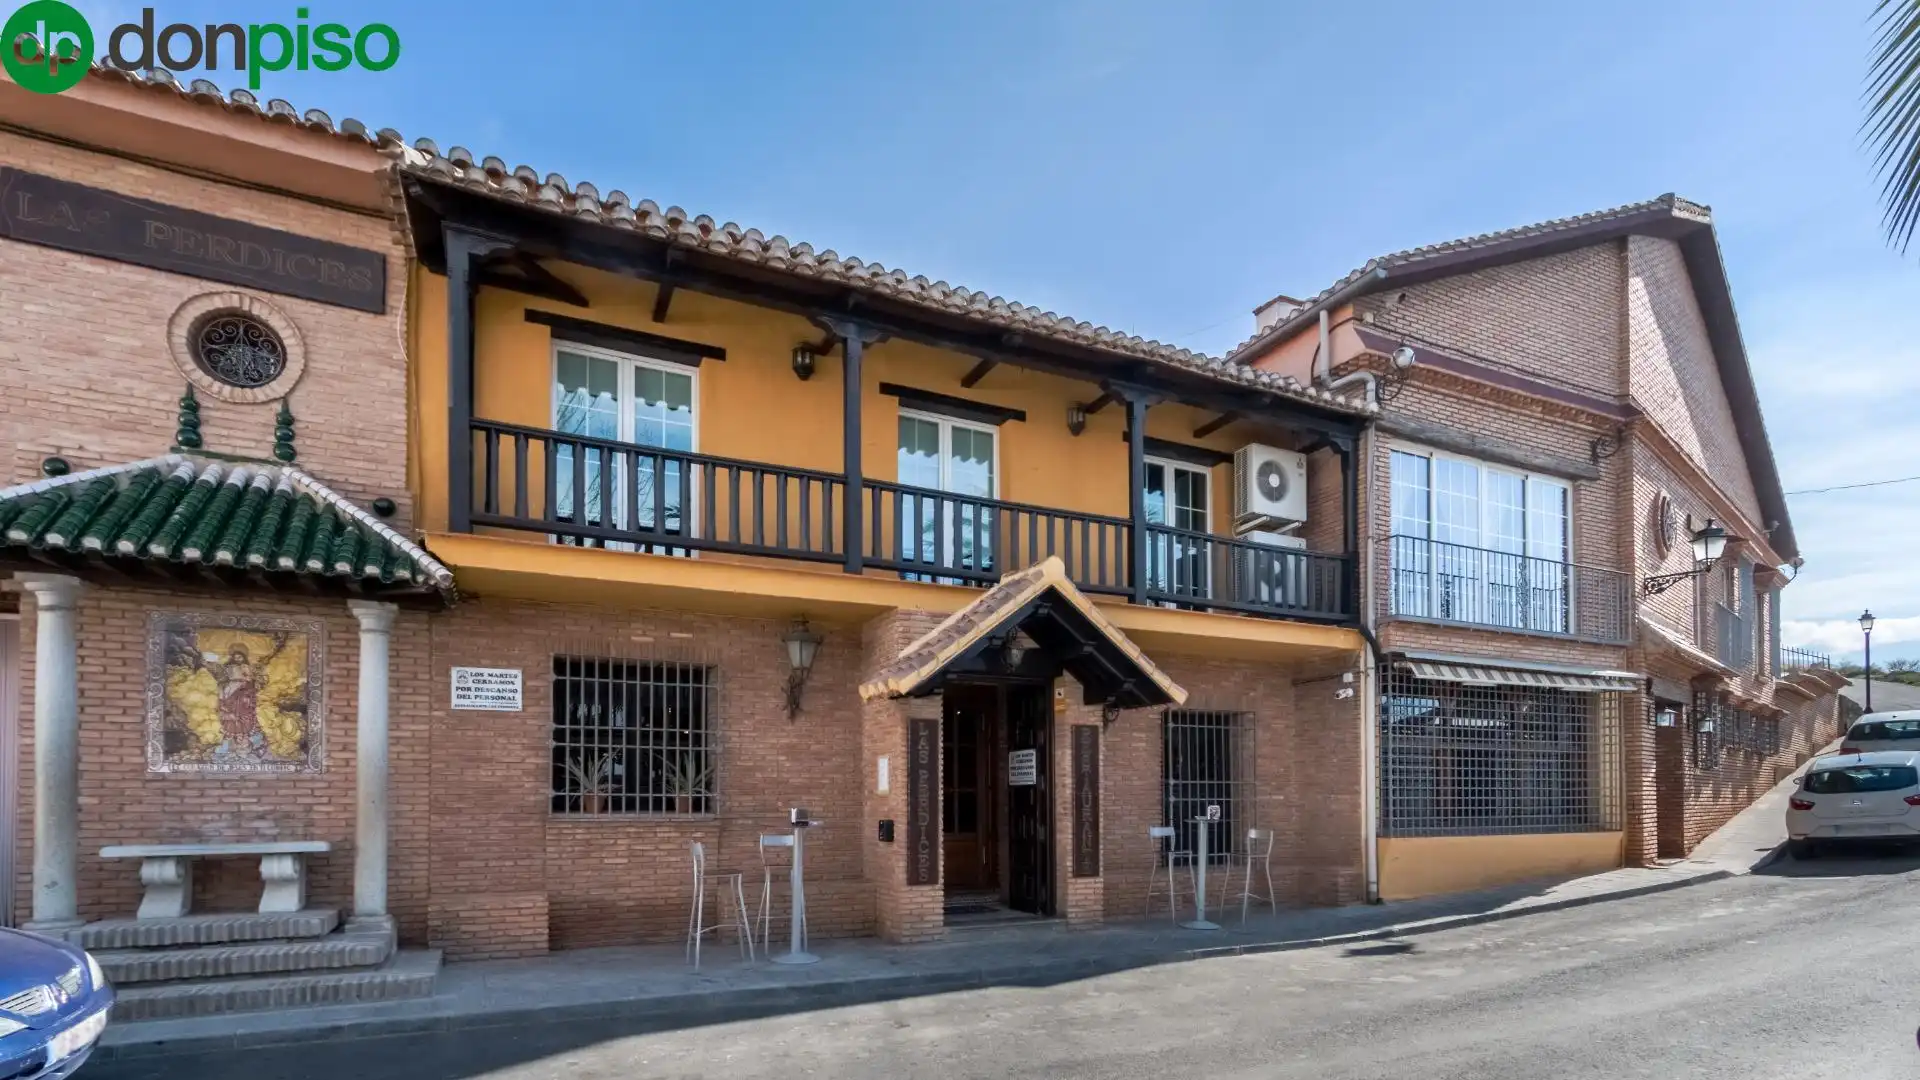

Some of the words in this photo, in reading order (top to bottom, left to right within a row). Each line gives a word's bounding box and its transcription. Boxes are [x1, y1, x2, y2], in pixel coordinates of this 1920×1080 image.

[143, 219, 374, 292] PERDICES
[474, 686, 519, 694] DESCANSO
[917, 722, 930, 764] LAS
